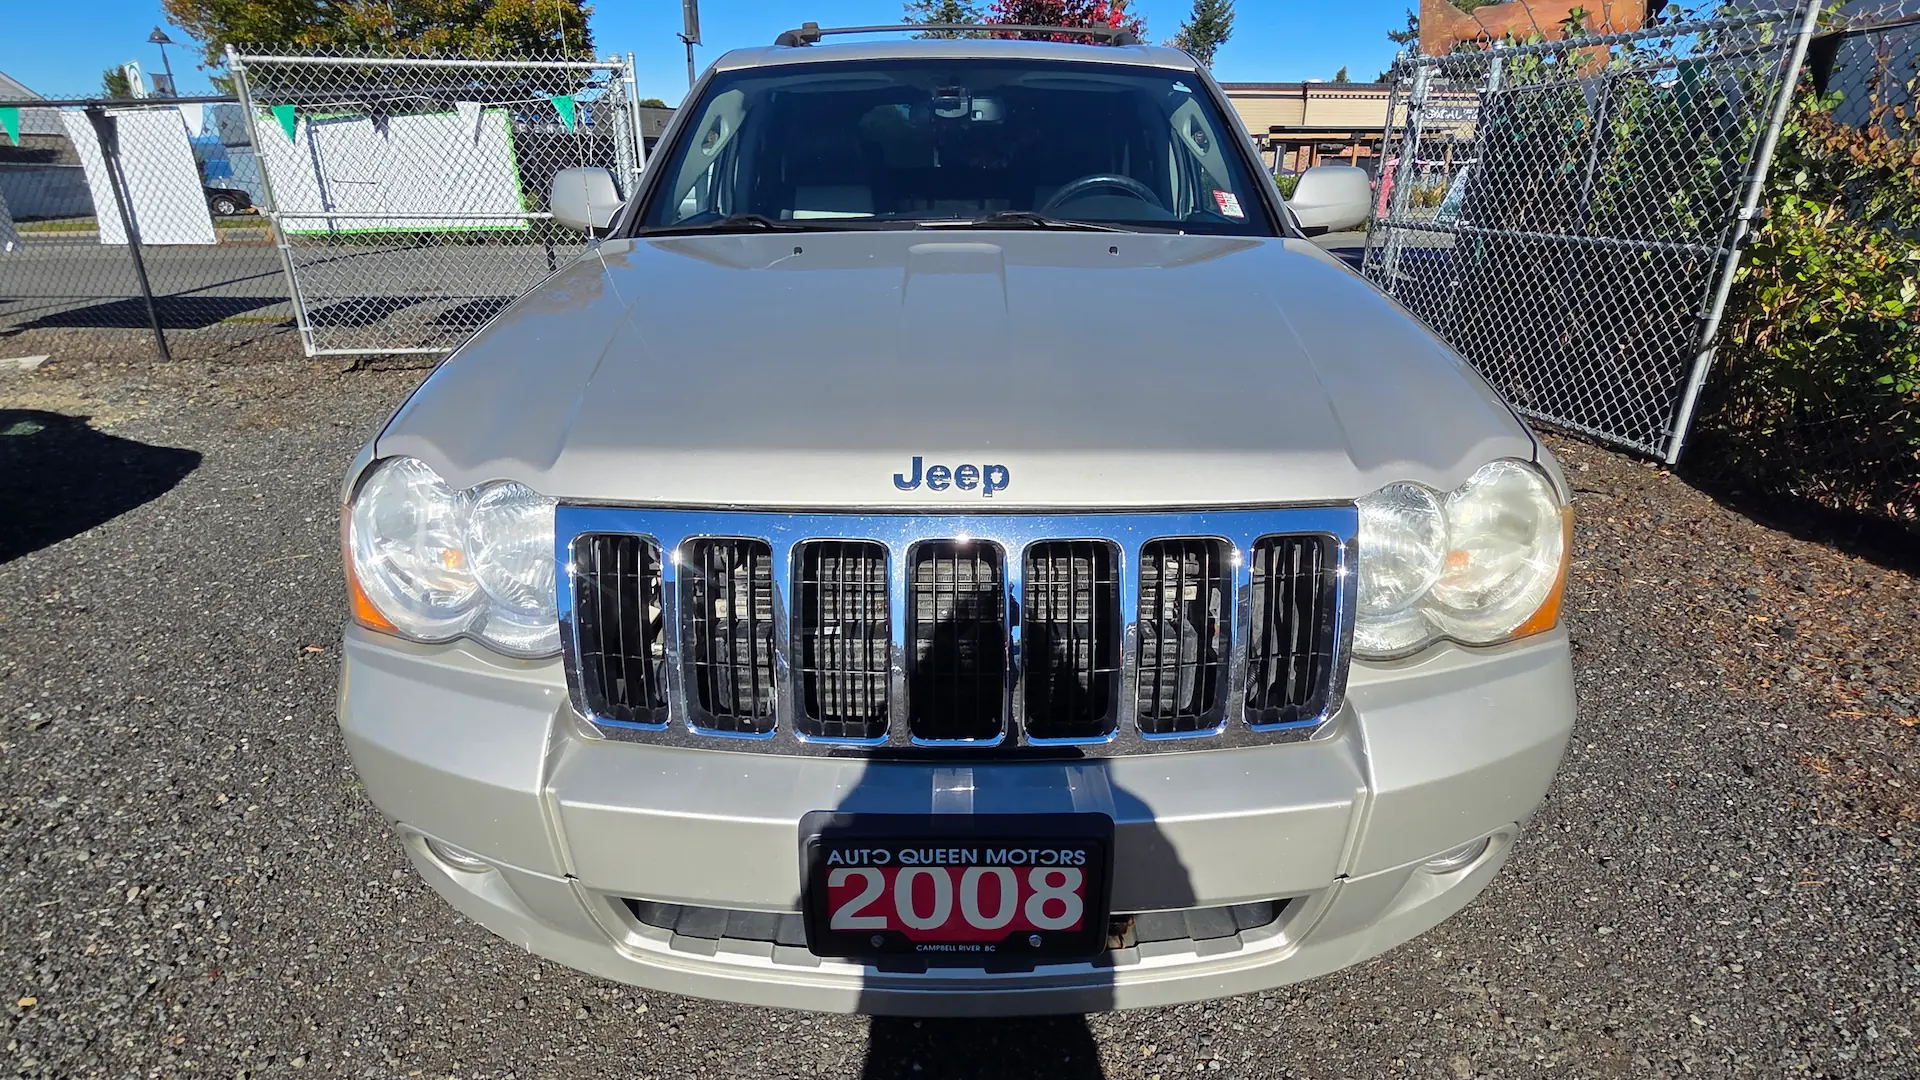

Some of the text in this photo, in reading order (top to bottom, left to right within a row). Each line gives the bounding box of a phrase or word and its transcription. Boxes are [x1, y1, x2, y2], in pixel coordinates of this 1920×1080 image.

[893, 456, 1010, 498] Jeep
[827, 849, 1086, 865] AUTO QUEEN MOTORS
[827, 867, 1084, 930] 2008
[916, 944, 957, 952] CAMPBELL
[958, 944, 980, 952] RIVER
